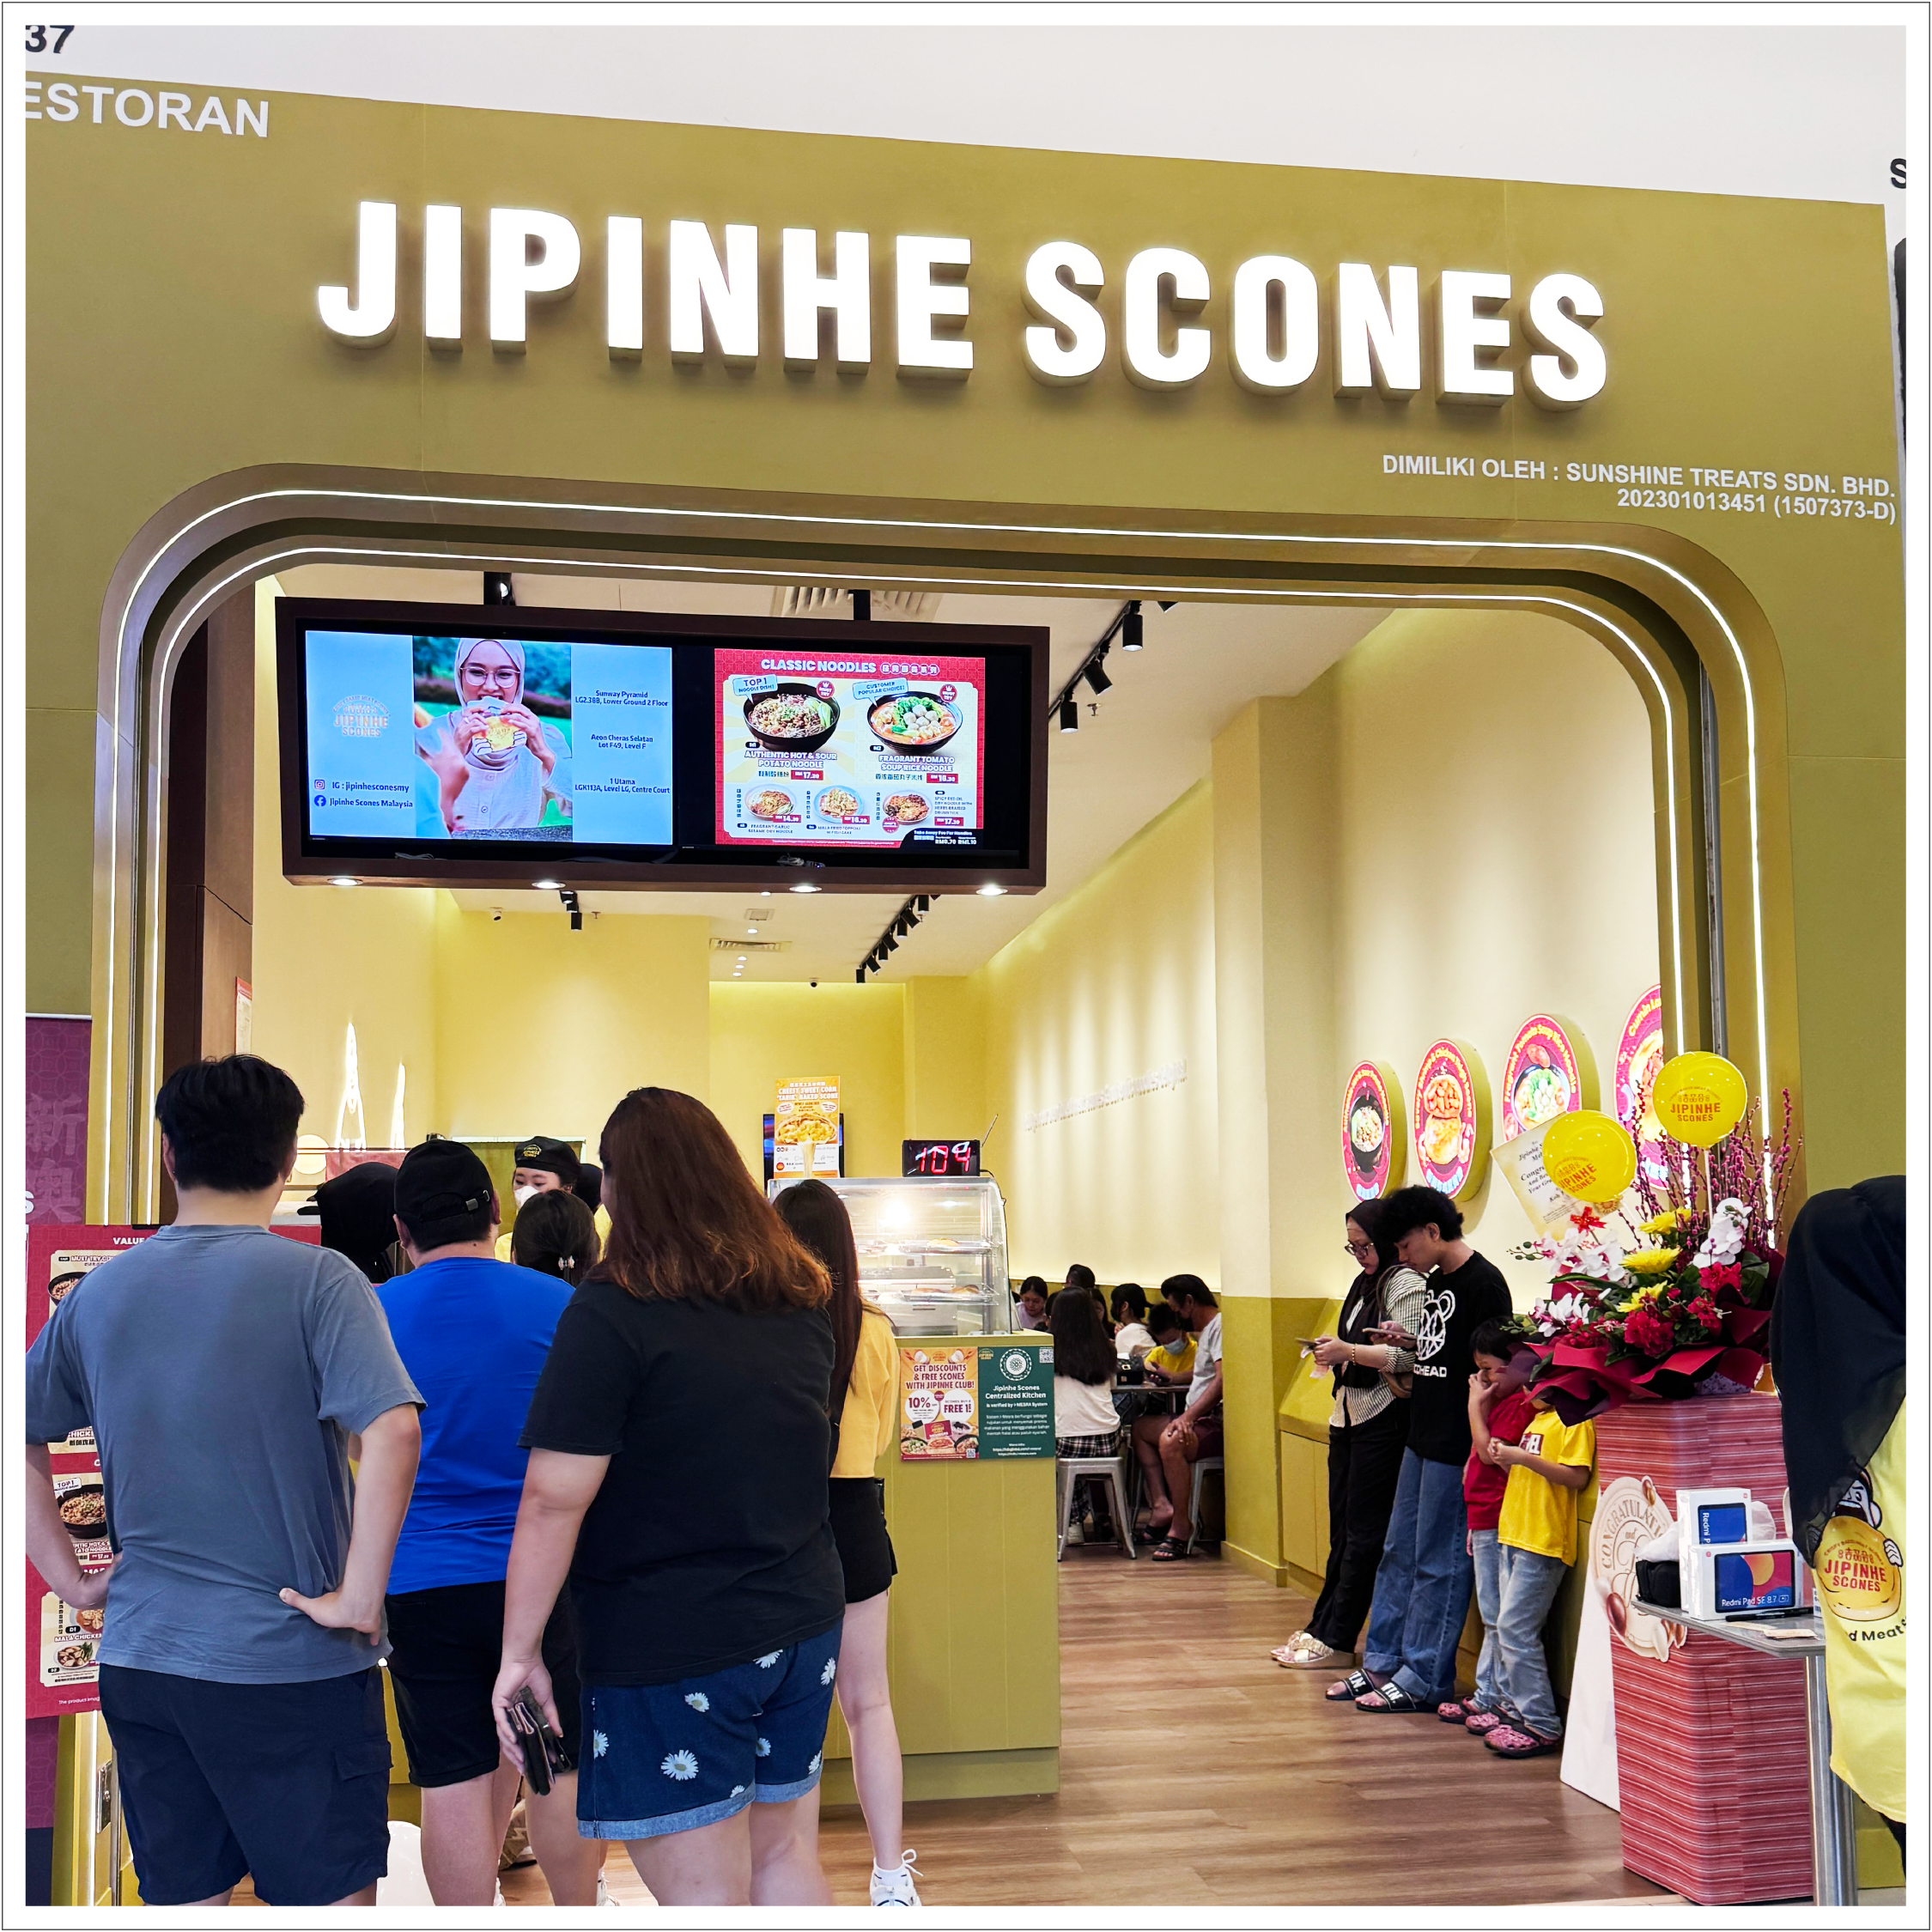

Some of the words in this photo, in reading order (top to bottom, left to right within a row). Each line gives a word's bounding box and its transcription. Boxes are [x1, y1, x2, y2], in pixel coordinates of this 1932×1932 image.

[26, 25, 75, 54] 37
[26, 81, 269, 137] ESTORAN
[316, 200, 975, 376] JIPINHE
[1022, 240, 1607, 406] SCONES
[1382, 454, 1475, 477] DIMILIKI
[1481, 458, 1545, 480] OLEH
[1566, 463, 1683, 486] SUNSHINE
[1691, 468, 1777, 490] TREATS
[1783, 472, 1837, 494] SDN.
[1844, 476, 1895, 498] BHD.
[1618, 489, 1765, 513] 202301013451
[1774, 495, 1896, 525] (1507373-D)
[761, 659, 816, 671] CLASSIC
[817, 660, 876, 673] NOODLES
[596, 690, 620, 698] Sunway
[334, 714, 389, 727] JIPINHE
[343, 727, 381, 737] SCONES
[744, 750, 790, 759] AUTHENTIC
[921, 756, 955, 764] TOMATO
[758, 759, 790, 768] POTATO
[345, 781, 410, 793] jipinhesconesmy
[330, 798, 354, 806] Jipinhe
[381, 799, 413, 809] Malaysia
[1628, 1004, 1651, 1037] Cumin
[1504, 1047, 1518, 1103] Fragrant
[1536, 1024, 1553, 1041] Soup
[1562, 1046, 1577, 1093] Noodle
[1670, 1102, 1721, 1114] JIPINHE
[1677, 1114, 1713, 1122] SCONES
[1519, 1147, 1539, 1161] Jipinhe
[1528, 1185, 1541, 1194] Your
[112, 1236, 145, 1245] VALUE
[908, 1397, 931, 1408] 10%
[944, 1404, 963, 1413] FREE
[965, 1404, 971, 1413] 1!
[1601, 1499, 1664, 1569] CONGRATULATI
[1825, 1559, 1886, 1583] JIPINHE
[1832, 1576, 1880, 1592] SCONES
[1722, 1598, 1741, 1607] Redmi
[1742, 1597, 1755, 1606] Pad
[1757, 1596, 1765, 1605] SE
[1862, 1625, 1905, 1641] Meat
